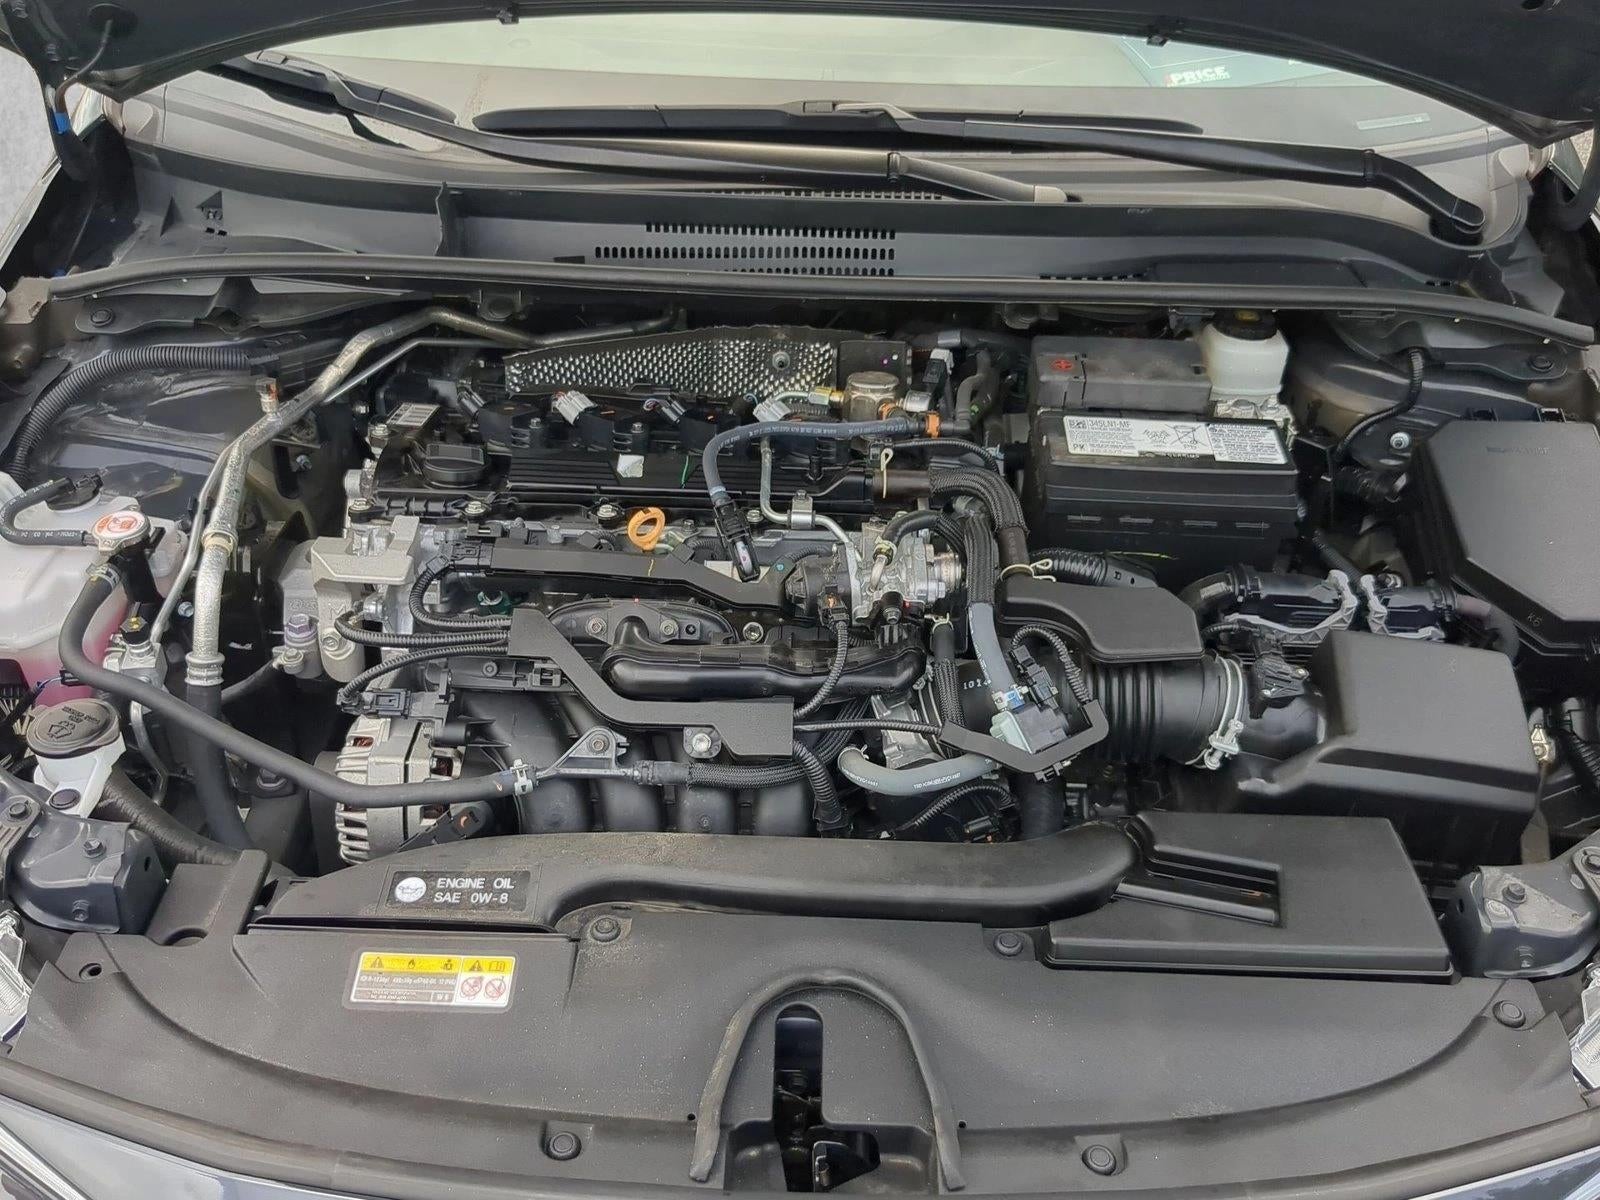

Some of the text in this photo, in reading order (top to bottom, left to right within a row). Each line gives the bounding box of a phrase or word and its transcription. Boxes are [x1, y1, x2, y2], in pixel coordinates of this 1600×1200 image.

[1170, 65, 1226, 85] PRICE
[436, 877, 516, 890] ENGINE OIL
[433, 891, 509, 904] SAE 0W-8
